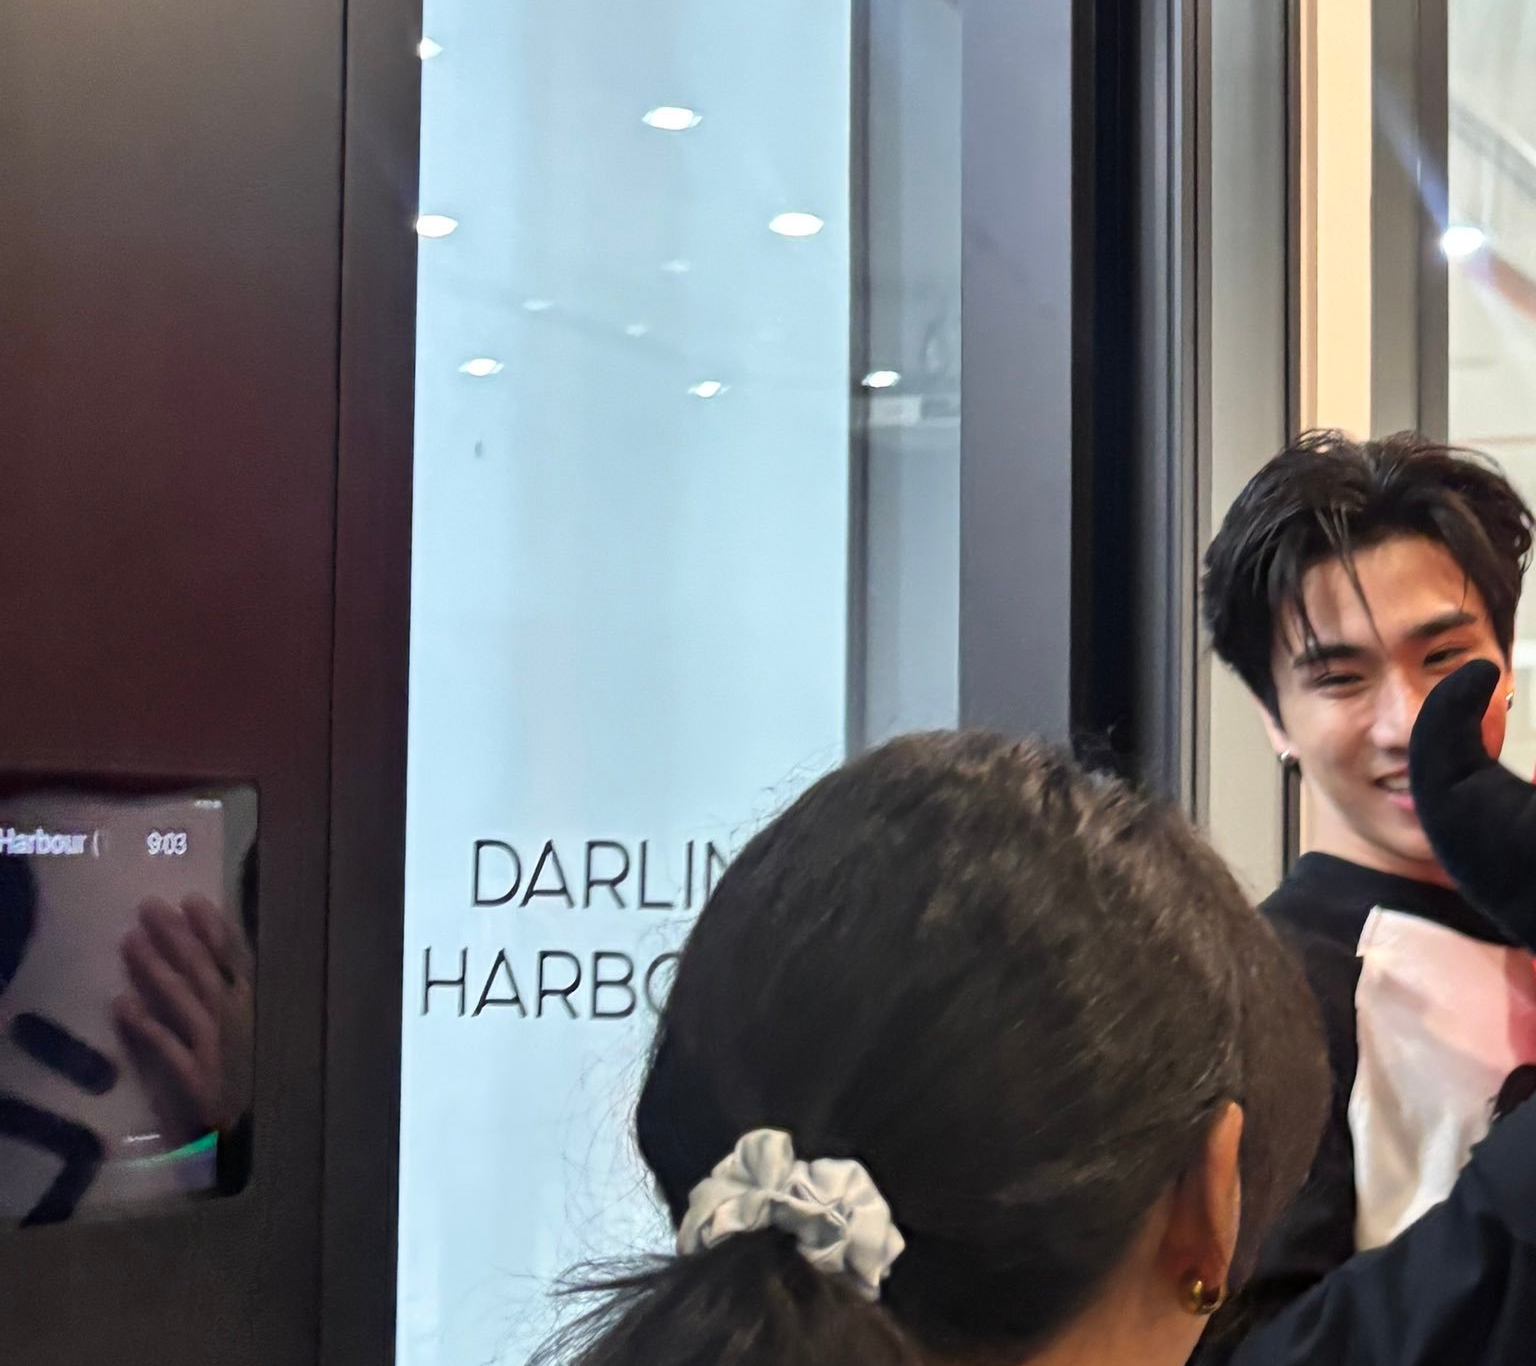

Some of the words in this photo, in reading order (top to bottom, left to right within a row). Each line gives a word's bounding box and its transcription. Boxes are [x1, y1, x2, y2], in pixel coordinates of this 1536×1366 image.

[0, 827, 87, 855] Harbour
[471, 838, 731, 910] DARLIN
[420, 946, 683, 1021] HARBO
